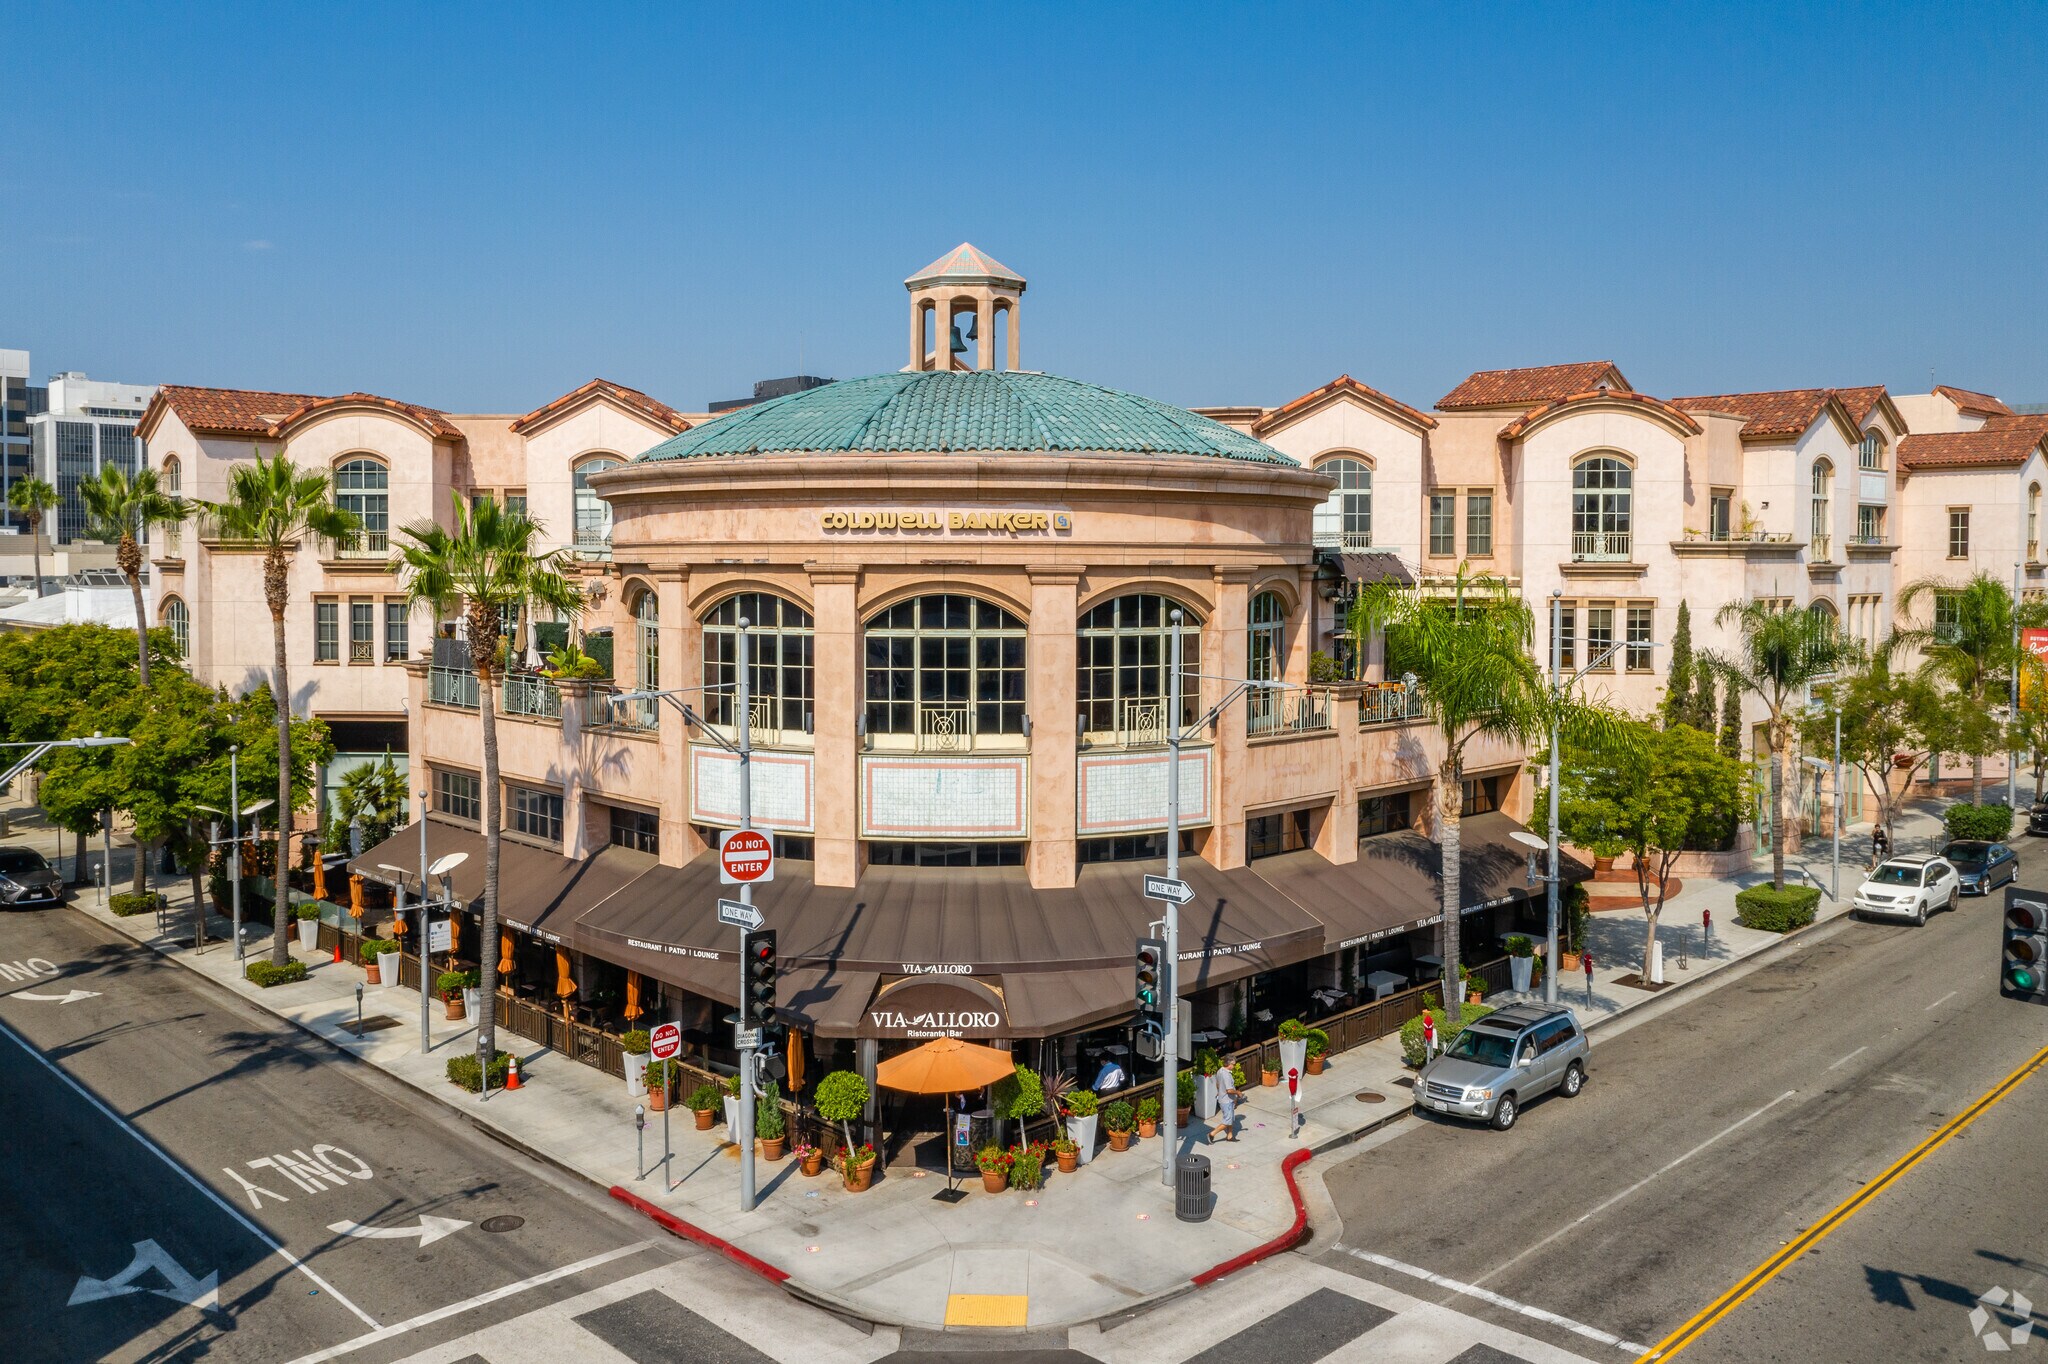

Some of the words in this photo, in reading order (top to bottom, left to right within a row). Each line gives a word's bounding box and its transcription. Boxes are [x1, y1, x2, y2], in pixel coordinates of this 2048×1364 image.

[730, 841, 742, 850] DO
[746, 840, 763, 849] NOT
[731, 863, 762, 873] ENTER
[1150, 882, 1165, 893] ONE
[1167, 885, 1181, 895] WAY
[724, 907, 738, 918] ONE
[739, 911, 753, 921] WAY
[506, 918, 529, 933] RESTAURANT
[531, 927, 543, 937] PATIO
[545, 932, 561, 943] LOUNGE
[1340, 935, 1368, 948] RESTAURANT
[1372, 930, 1384, 939] PATIO
[1388, 925, 1404, 935] LOUNGE
[627, 939, 662, 951] RESTAURANT
[668, 946, 686, 956] PATIO
[693, 950, 719, 960] LOUNGE
[1213, 947, 1232, 956] PATIO
[1238, 942, 1262, 952] LOUNGE
[902, 964, 921, 974] VIA
[930, 964, 972, 974] ALLORO
[871, 1012, 907, 1028] VIA
[922, 1011, 1000, 1028] ALLORO
[655, 1032, 664, 1040] DO
[665, 1029, 676, 1037] NOT
[907, 1029, 946, 1037] Ristorante
[949, 1029, 963, 1037] Bar
[657, 1044, 675, 1054] ENTER
[222, 1143, 373, 1210] ONLY
